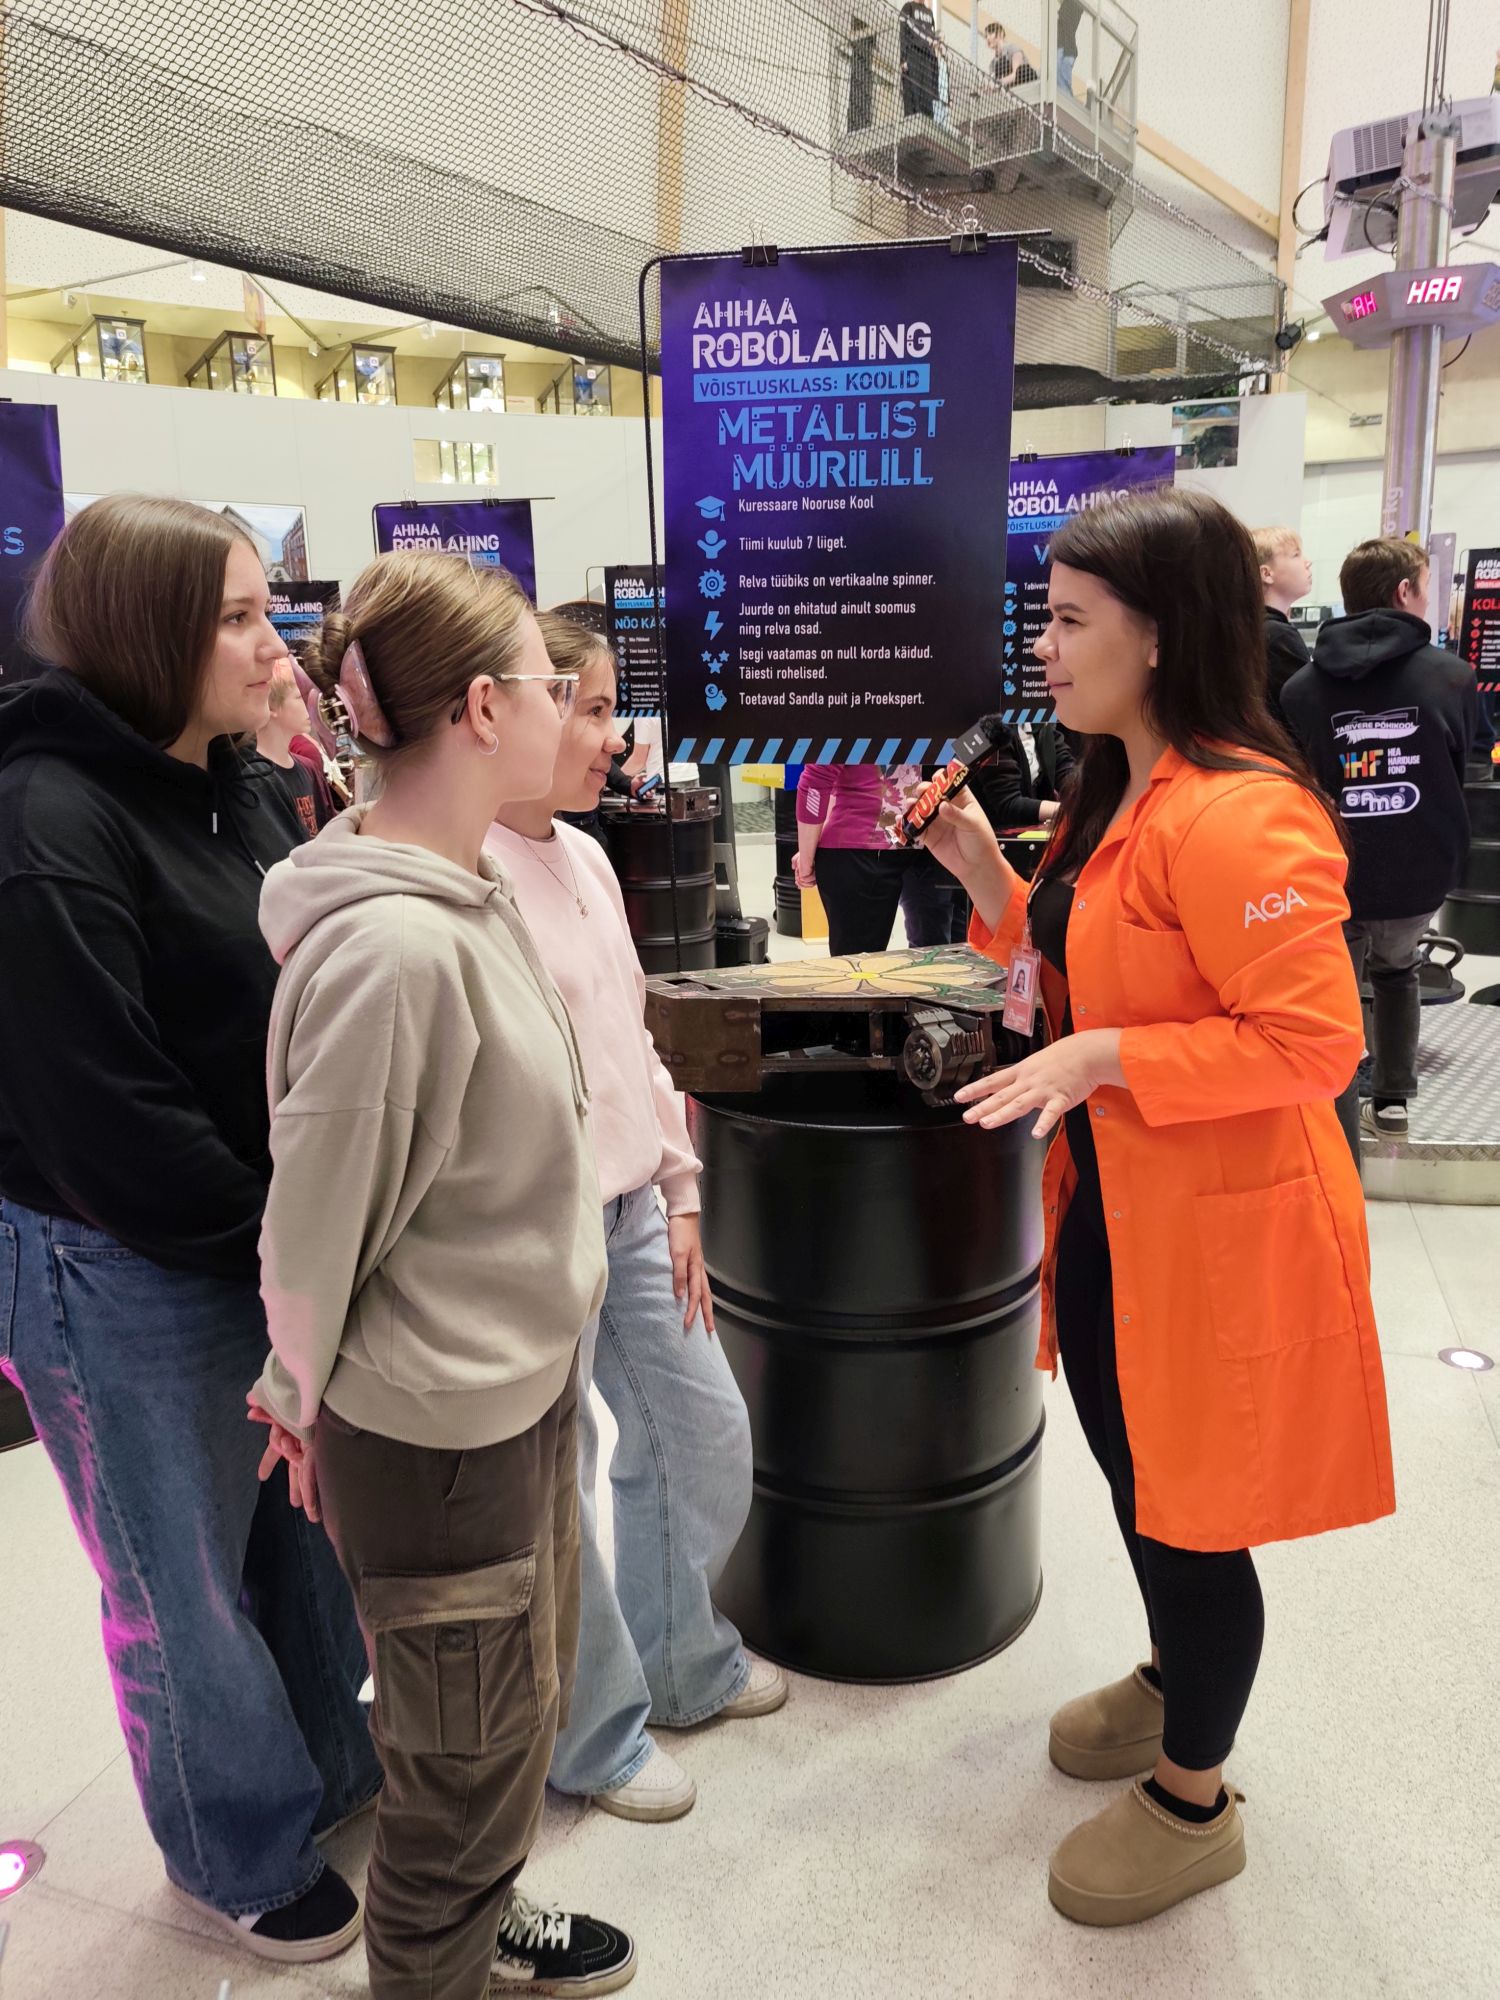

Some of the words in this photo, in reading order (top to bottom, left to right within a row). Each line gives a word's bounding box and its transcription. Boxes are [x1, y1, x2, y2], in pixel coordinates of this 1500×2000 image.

[693, 298, 798, 329] AHHAA
[693, 322, 931, 368] ROBOLAHING
[699, 378, 839, 397] VÕISTLUSKLASS:
[846, 370, 919, 391] KOOLID
[719, 399, 945, 445] METALLIST
[733, 443, 933, 490] MÜÜRILILL
[738, 499, 798, 512] Kuressaare
[802, 497, 846, 510] Nooruse
[850, 496, 874, 509] Kool
[393, 523, 440, 537] AHHAA
[739, 537, 764, 551] Tiimi
[767, 537, 803, 550] kuulub
[807, 536, 813, 549] 7
[817, 536, 847, 552] liiget.
[614, 579, 645, 588] AHHAA
[739, 575, 767, 588] Relva
[771, 574, 808, 587] tüübiks
[813, 577, 826, 586] on
[830, 573, 889, 586] vertikaalne
[893, 573, 936, 588] spinner.
[739, 602, 774, 616] Juurde
[778, 605, 791, 615] on
[794, 601, 837, 615] ehitatud
[841, 601, 870, 614] ainult
[875, 602, 916, 613] soomus
[614, 616, 639, 630] NÕO
[739, 623, 761, 638] ning
[765, 622, 792, 635] relva
[795, 622, 822, 635] osad.
[739, 648, 763, 663] Isegi
[767, 649, 817, 660] vaatamas
[821, 649, 833, 659] on
[837, 646, 857, 659] null
[861, 646, 890, 659] korda
[894, 645, 934, 660] käidud.
[739, 666, 774, 680] Täiesti
[777, 666, 828, 680] rohelised.
[739, 692, 785, 705] Toetavad
[789, 691, 824, 705] Sandla
[828, 692, 849, 708] puit
[852, 692, 860, 708] ja
[865, 690, 925, 706] Proekspert.
[1336, 722, 1373, 734] TABIVERE
[1387, 747, 1402, 757] HEA
[1387, 755, 1421, 765] HARIDUSE
[1387, 766, 1406, 775] FOND
[1244, 886, 1308, 928] AGA
